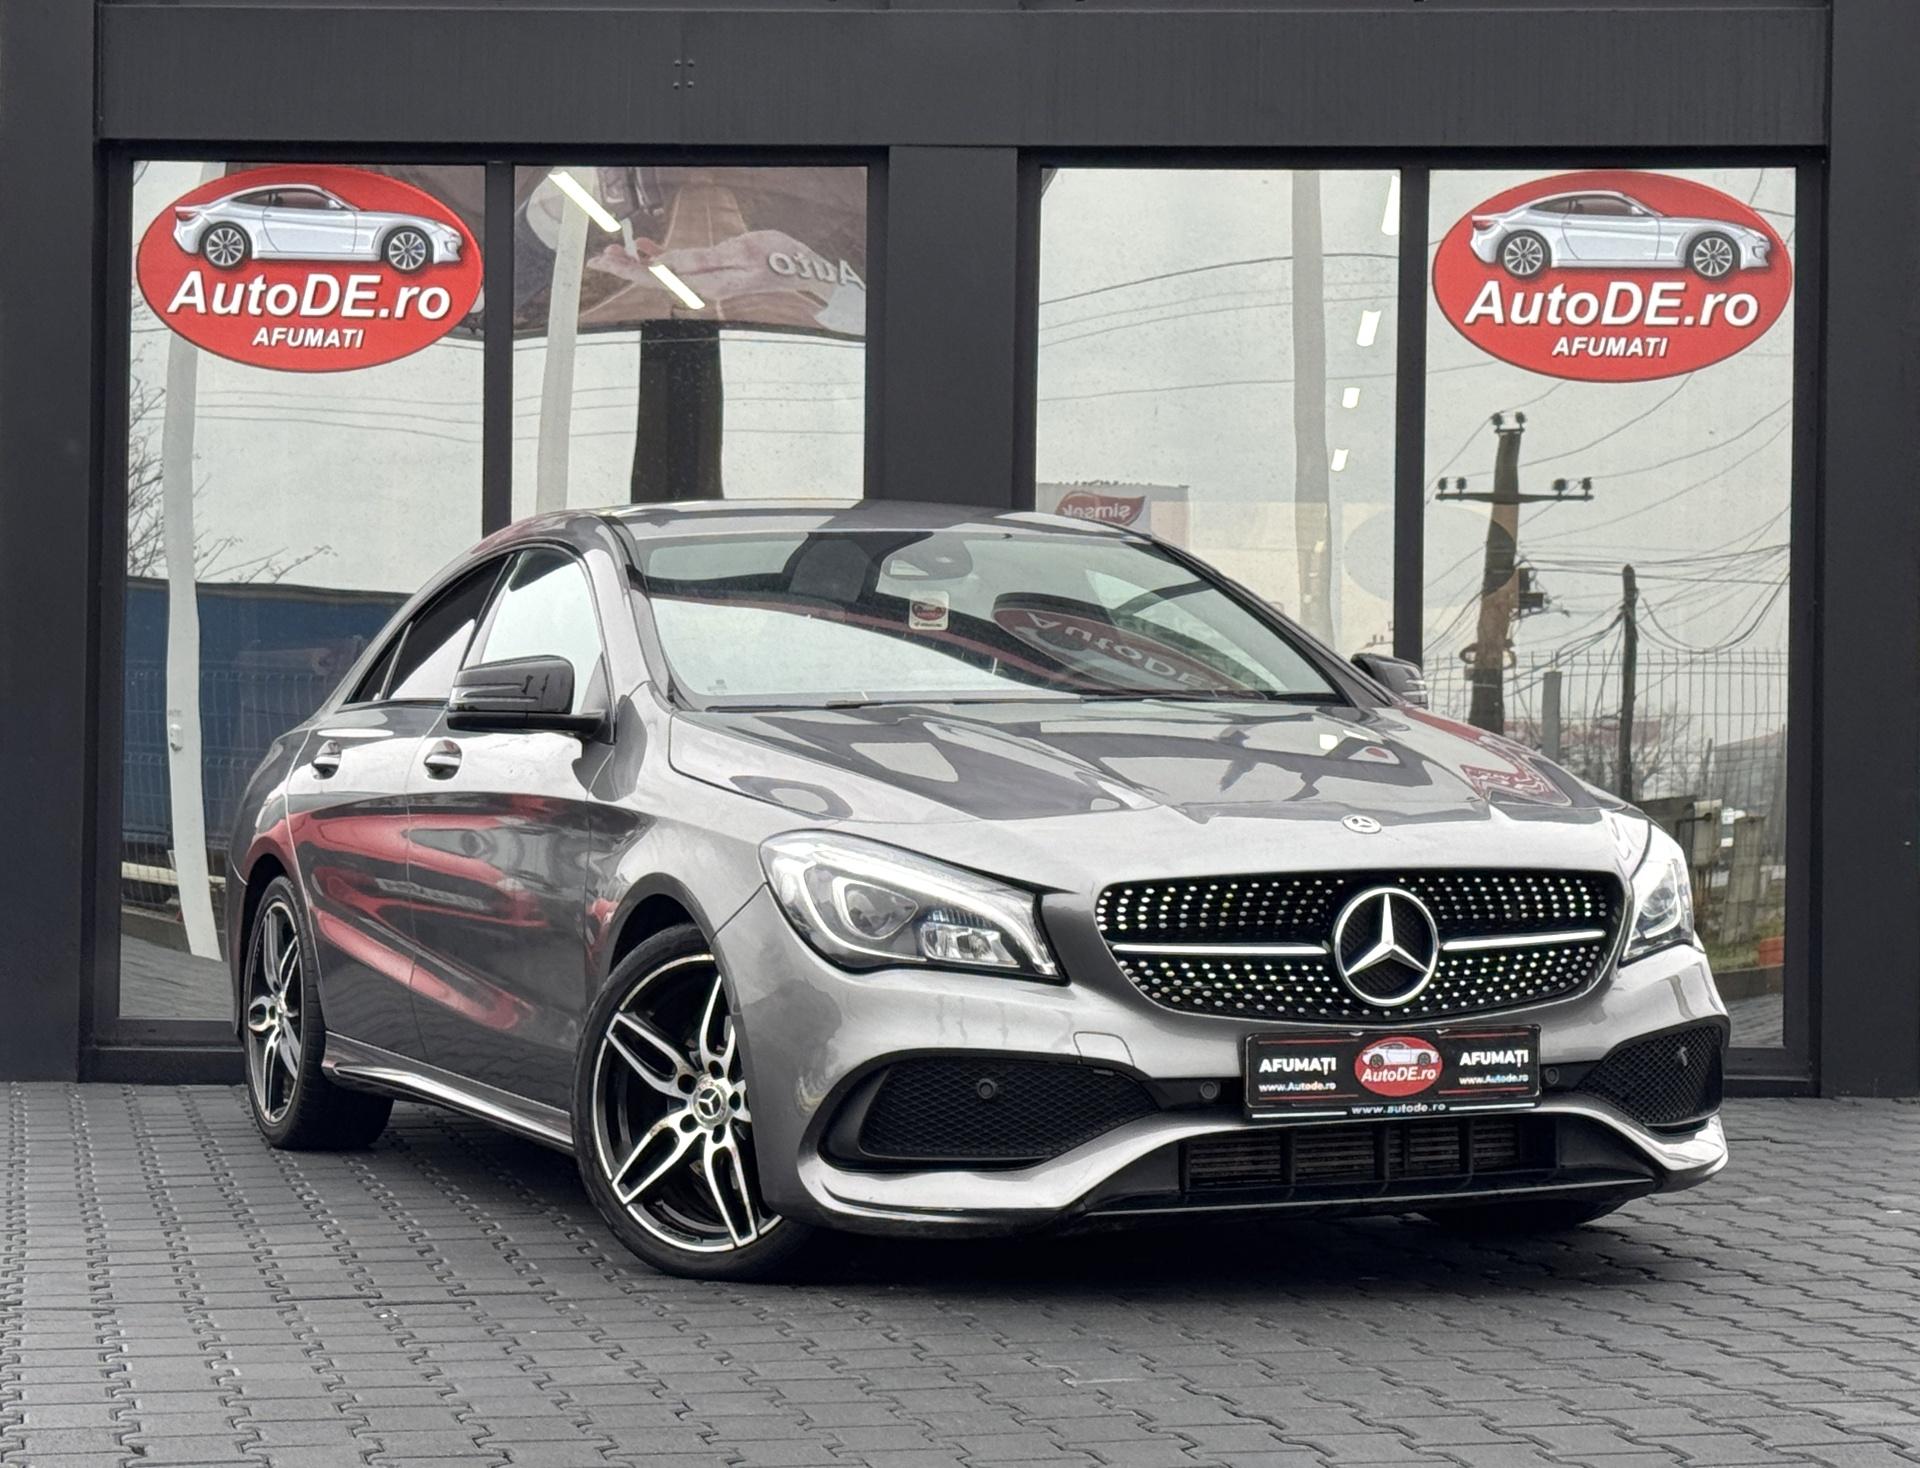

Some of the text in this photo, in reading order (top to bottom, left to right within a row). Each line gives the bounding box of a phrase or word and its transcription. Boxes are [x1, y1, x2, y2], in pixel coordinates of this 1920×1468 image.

[166, 270, 451, 320] AutoDE.ro
[1464, 280, 1759, 327] AutoDE.ro
[251, 327, 365, 348] AFUMATI
[1552, 336, 1668, 358] AFUMATI
[1360, 1066, 1437, 1083] AutoDE.ro
[1351, 1103, 1446, 1115] www.autode.ro
